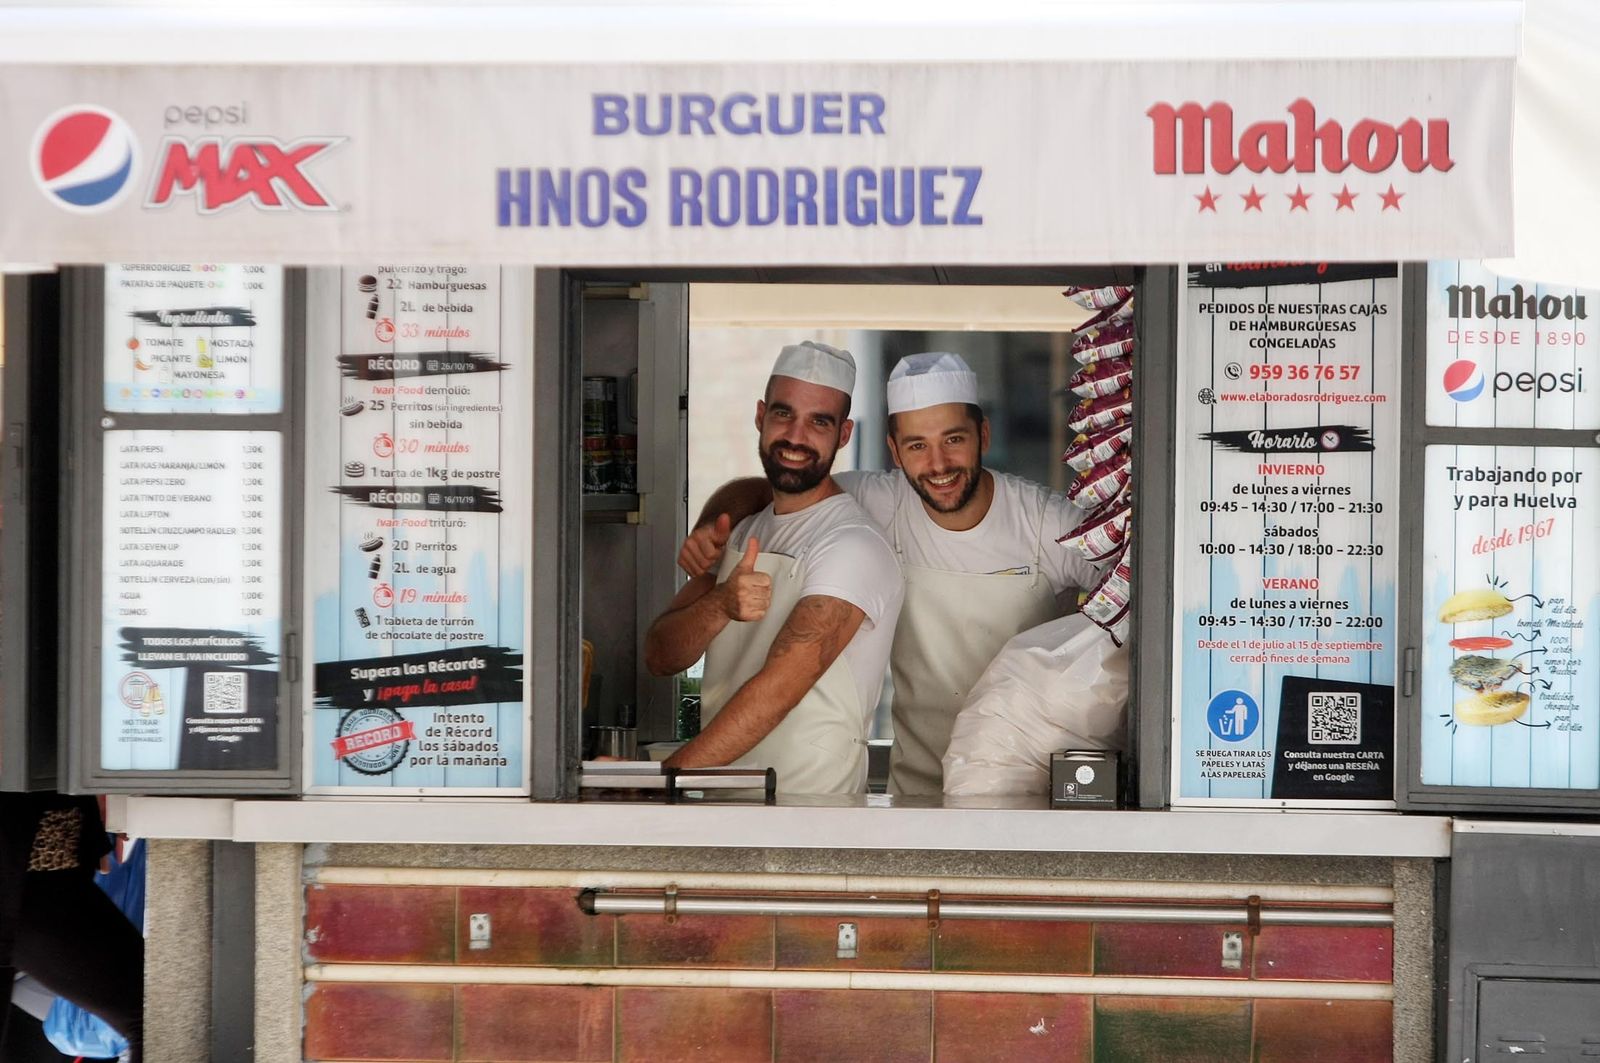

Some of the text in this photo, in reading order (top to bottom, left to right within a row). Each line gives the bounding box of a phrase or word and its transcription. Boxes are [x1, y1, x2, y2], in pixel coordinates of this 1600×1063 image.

[164, 102, 248, 126] pepsi
[592, 93, 886, 135] BURGUER
[1146, 98, 1455, 175] Mahou
[148, 136, 341, 211] MAX
[496, 167, 983, 228] HNOS RODRIGUEZ
[1206, 263, 1221, 272] en
[386, 279, 487, 292] 22 Hamburguesas
[1446, 284, 1588, 320] Mahou
[1199, 304, 1387, 316] PEDIDOS DE NUESTRAS CAJAS
[400, 323, 471, 338] 33 minutos
[1229, 321, 1356, 332] DE HAMBURGUESAS
[146, 339, 254, 347] TOMATE MOSTAZA
[1249, 338, 1336, 348] CONGELADAS
[1448, 331, 1585, 345] DESDE 1890
[151, 355, 191, 363] PICANTE
[367, 357, 474, 370] RÉCORD 26/10/19
[174, 371, 225, 379] MAYONESA
[1250, 365, 1360, 380] 959 36 76 57
[1493, 368, 1582, 398] pepsi
[1221, 393, 1386, 404] www.elaboradosrodriguez.com
[369, 401, 503, 412] 25 Perritos (sin ingredientes)
[409, 420, 462, 429] sin bebida
[1248, 431, 1317, 449] Horario
[397, 439, 471, 453] 30 minutos
[371, 468, 500, 481] 1 tarta de 1kg de postre
[1258, 465, 1325, 475] INVIERNO
[1447, 466, 1582, 486] Trabajando por
[1233, 484, 1351, 495] de lunes a viernes
[369, 490, 421, 503] RÉCORD
[1454, 493, 1577, 510] y para Huelva
[1200, 502, 1383, 513] 09:45 14:30 17:00 21:30
[377, 519, 399, 527] Ivan
[401, 519, 428, 527] Food
[1264, 526, 1318, 537] sábados
[1472, 518, 1555, 555] desde 1967
[392, 541, 457, 551] 20 Perritos
[1200, 544, 1383, 555] 10:00 14:30 18:00 22:30
[1263, 579, 1319, 589] VERANO
[400, 589, 467, 603] 19 minutos
[1230, 598, 1349, 609] de lunes a viernes
[384, 617, 422, 625] tableta
[425, 617, 438, 625] de
[441, 616, 474, 626] turrón
[1199, 616, 1383, 627] 09:45 14:30 17:30 22:00
[450, 633, 484, 641] postre
[1198, 640, 1228, 648] Desde
[1249, 641, 1260, 649] de
[1262, 641, 1284, 651] julio
[1287, 641, 1296, 649] al
[1299, 641, 1308, 649] 15
[1311, 641, 1323, 649] de
[1325, 641, 1382, 651] septiembre
[1230, 654, 1268, 663] cerrado
[1271, 654, 1295, 663] fines
[1298, 654, 1309, 663] de
[351, 658, 486, 680] Supera los Récords
[363, 676, 477, 703] y ¡paga la casa!
[433, 713, 484, 723] Intento
[426, 726, 492, 737] de Récord
[419, 741, 498, 751] los sábados
[1284, 751, 1384, 759] Consulta nuestra CARTA
[410, 755, 507, 767] por la mañana
[1295, 762, 1327, 771] déjanos
[1346, 761, 1379, 770] RESEÑA
[1325, 774, 1355, 783] Google
